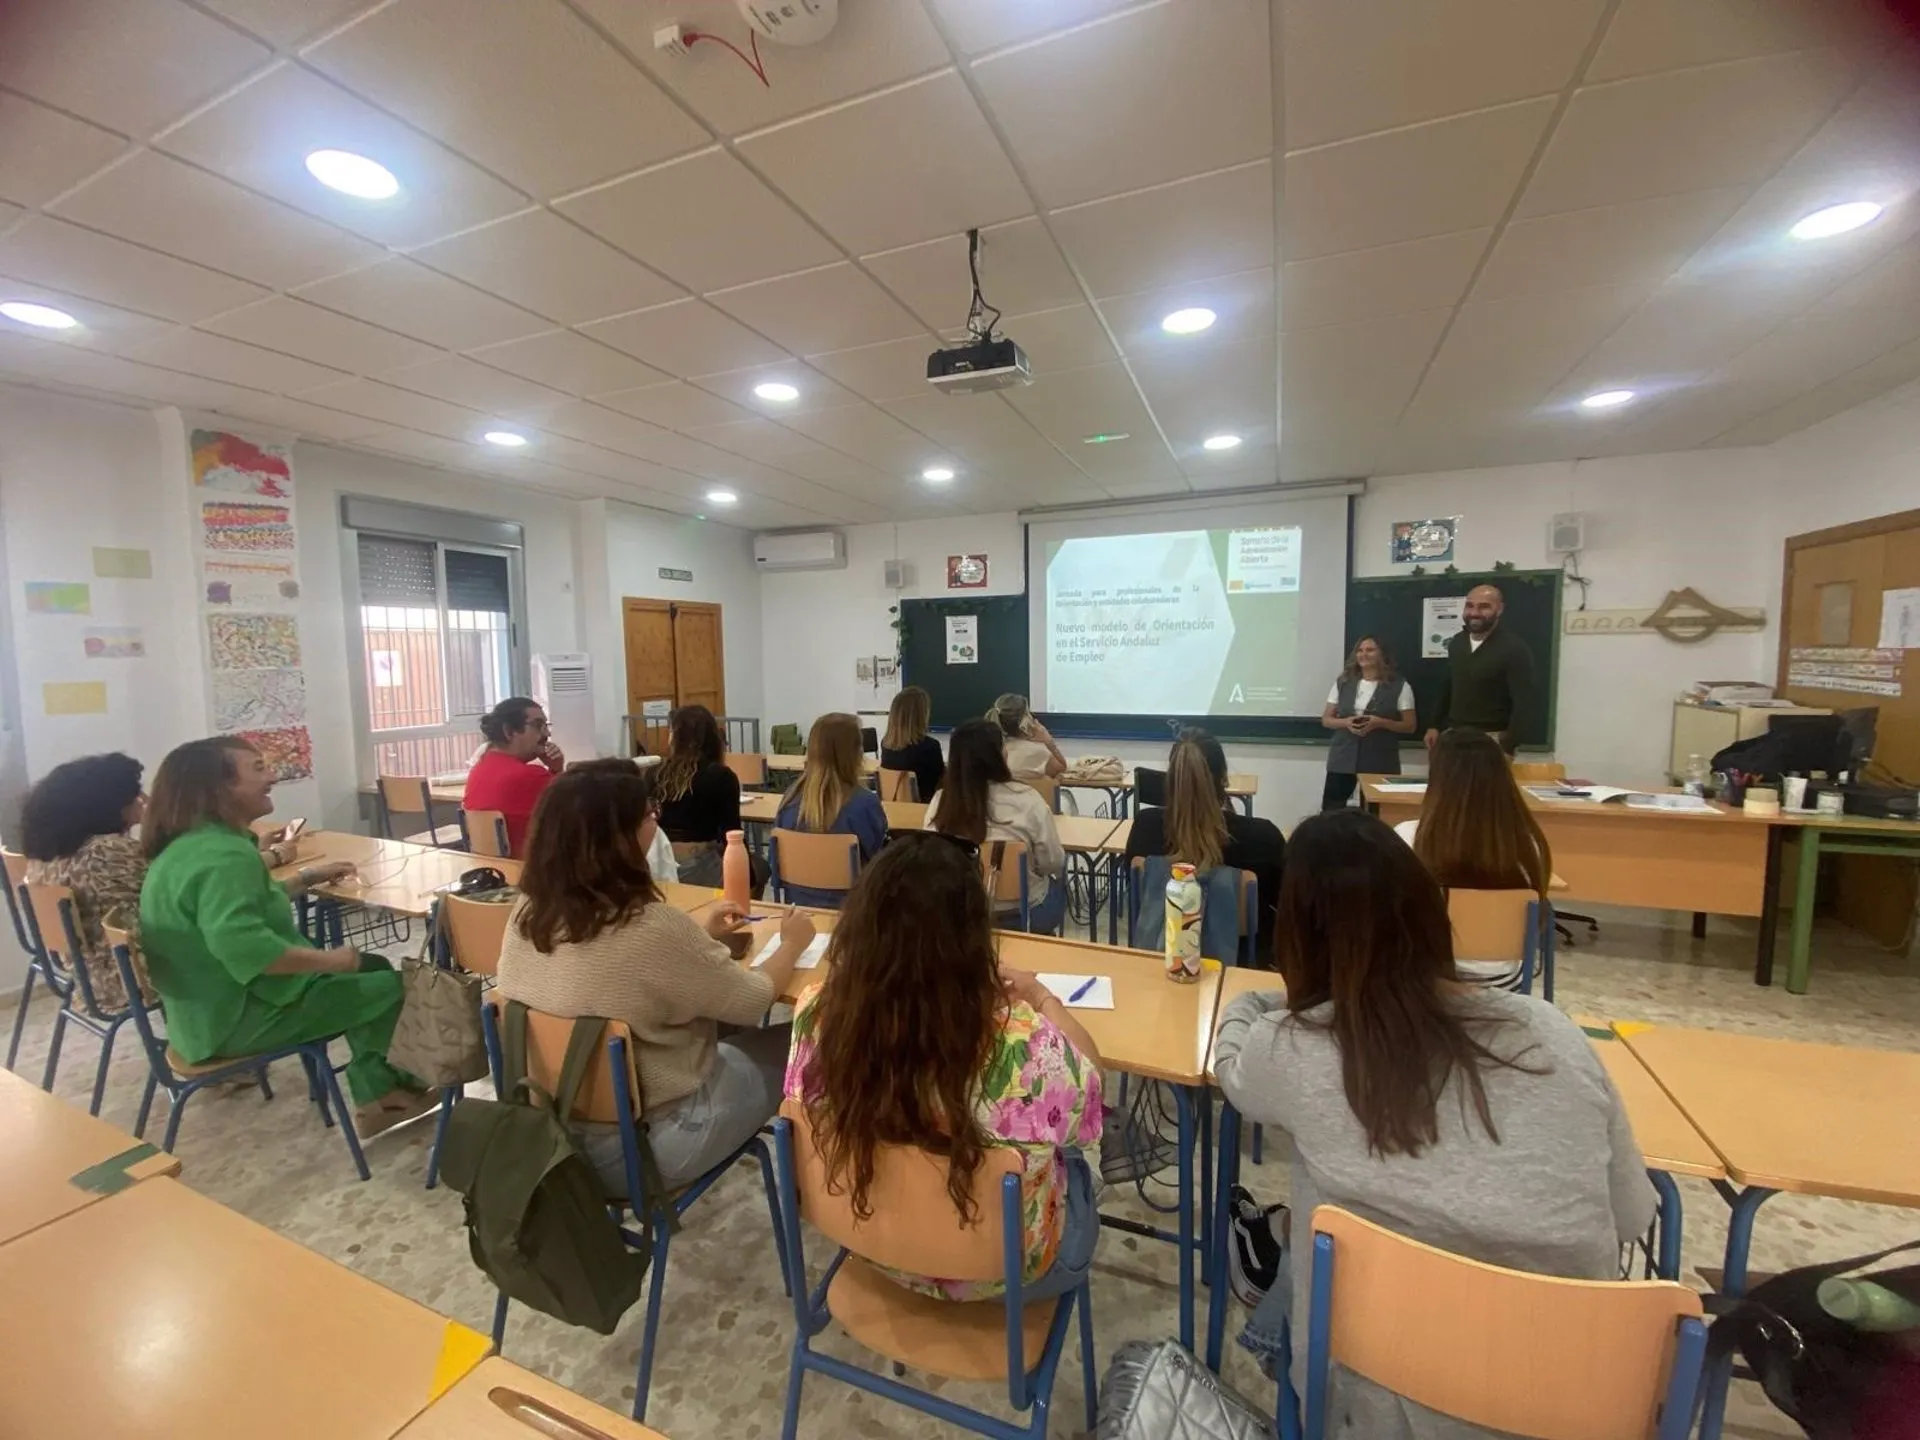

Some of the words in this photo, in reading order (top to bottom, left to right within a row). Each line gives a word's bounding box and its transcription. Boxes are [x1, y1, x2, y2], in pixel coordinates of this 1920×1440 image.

[1055, 623, 1086, 633] Nuevo
[1091, 620, 1128, 633] modelo
[1134, 620, 1146, 632] de
[1153, 617, 1215, 631] Orientación
[1056, 638, 1067, 648] en
[1069, 636, 1079, 648] el
[1080, 635, 1118, 648] Servicio
[1120, 633, 1160, 647] Andaluz
[1055, 651, 1067, 662] de
[1069, 651, 1105, 664] Empleo
